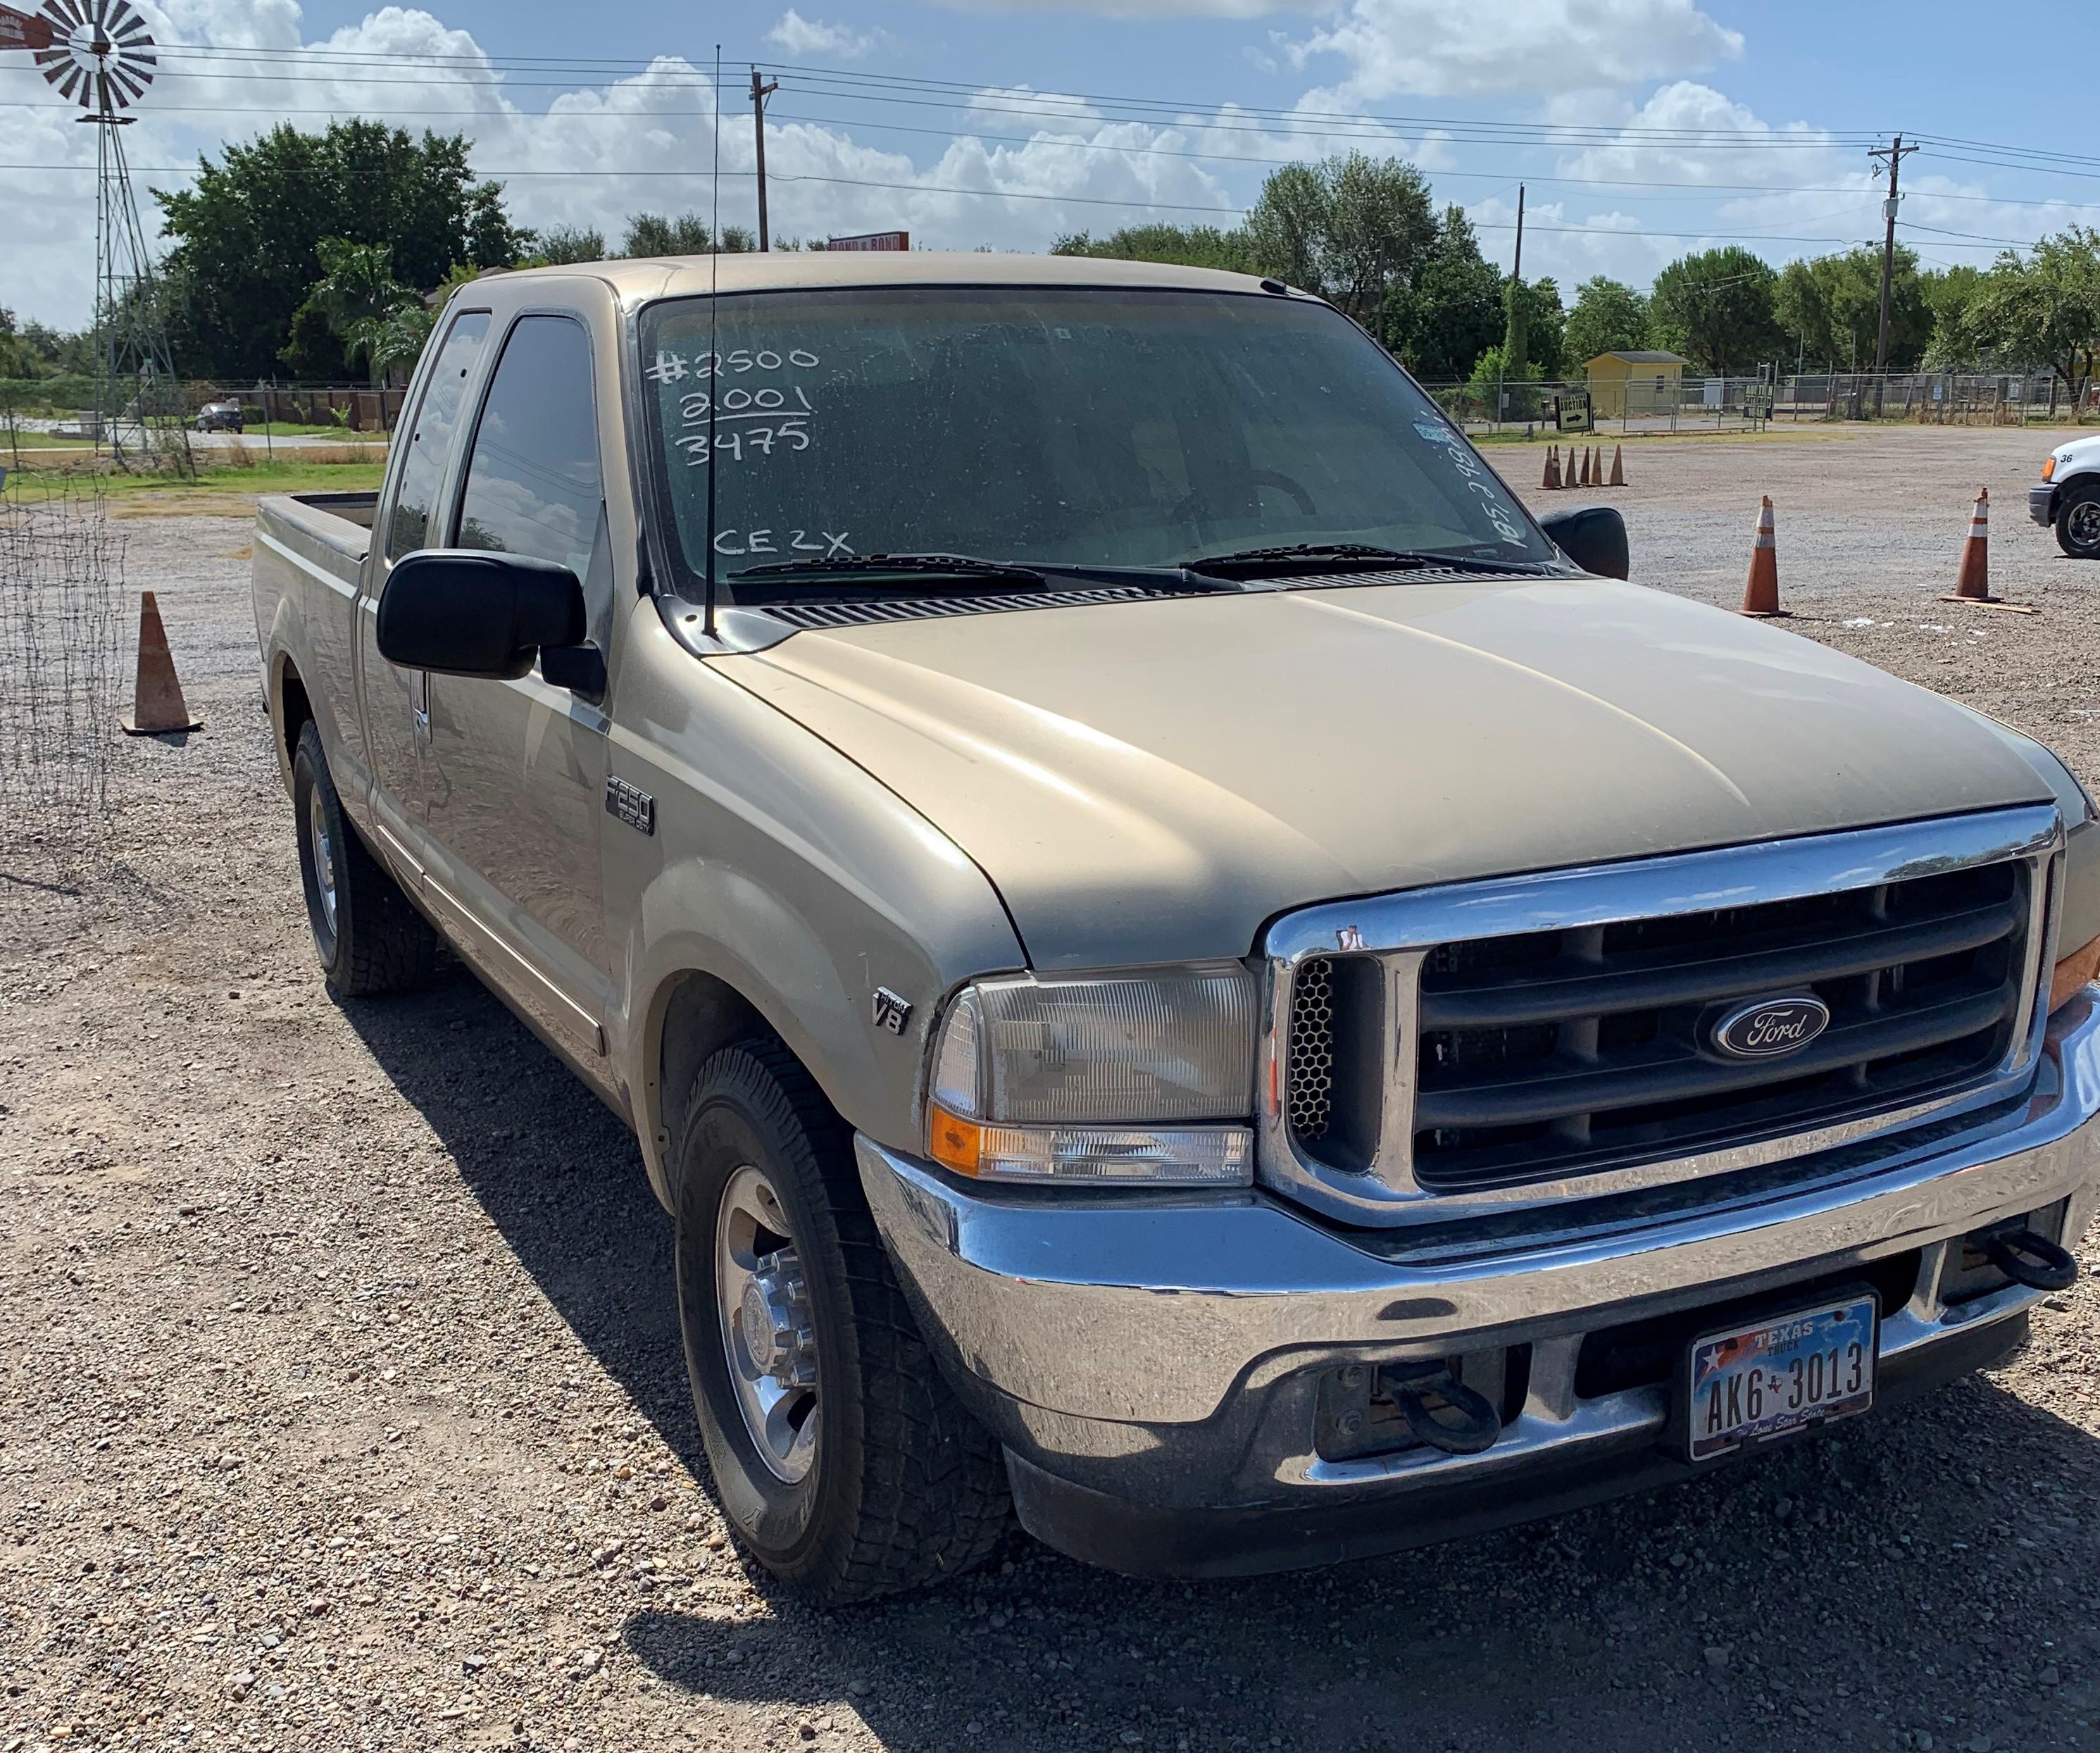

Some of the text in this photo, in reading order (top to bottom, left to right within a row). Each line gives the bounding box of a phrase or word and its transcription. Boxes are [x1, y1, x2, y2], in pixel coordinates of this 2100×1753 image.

[679, 386, 814, 418] 2001
[1561, 399, 1587, 412] AUCTION
[675, 421, 811, 466] 3475
[2061, 454, 2073, 463] 36
[713, 529, 778, 555] CE
[873, 992, 902, 1035] V8
[1746, 1009, 1808, 1046] Ford
[1755, 1321, 1815, 1349] TEXAS
[1768, 1340, 1800, 1357] TRUCK
[1707, 1342, 1863, 1435] AK6 3013
